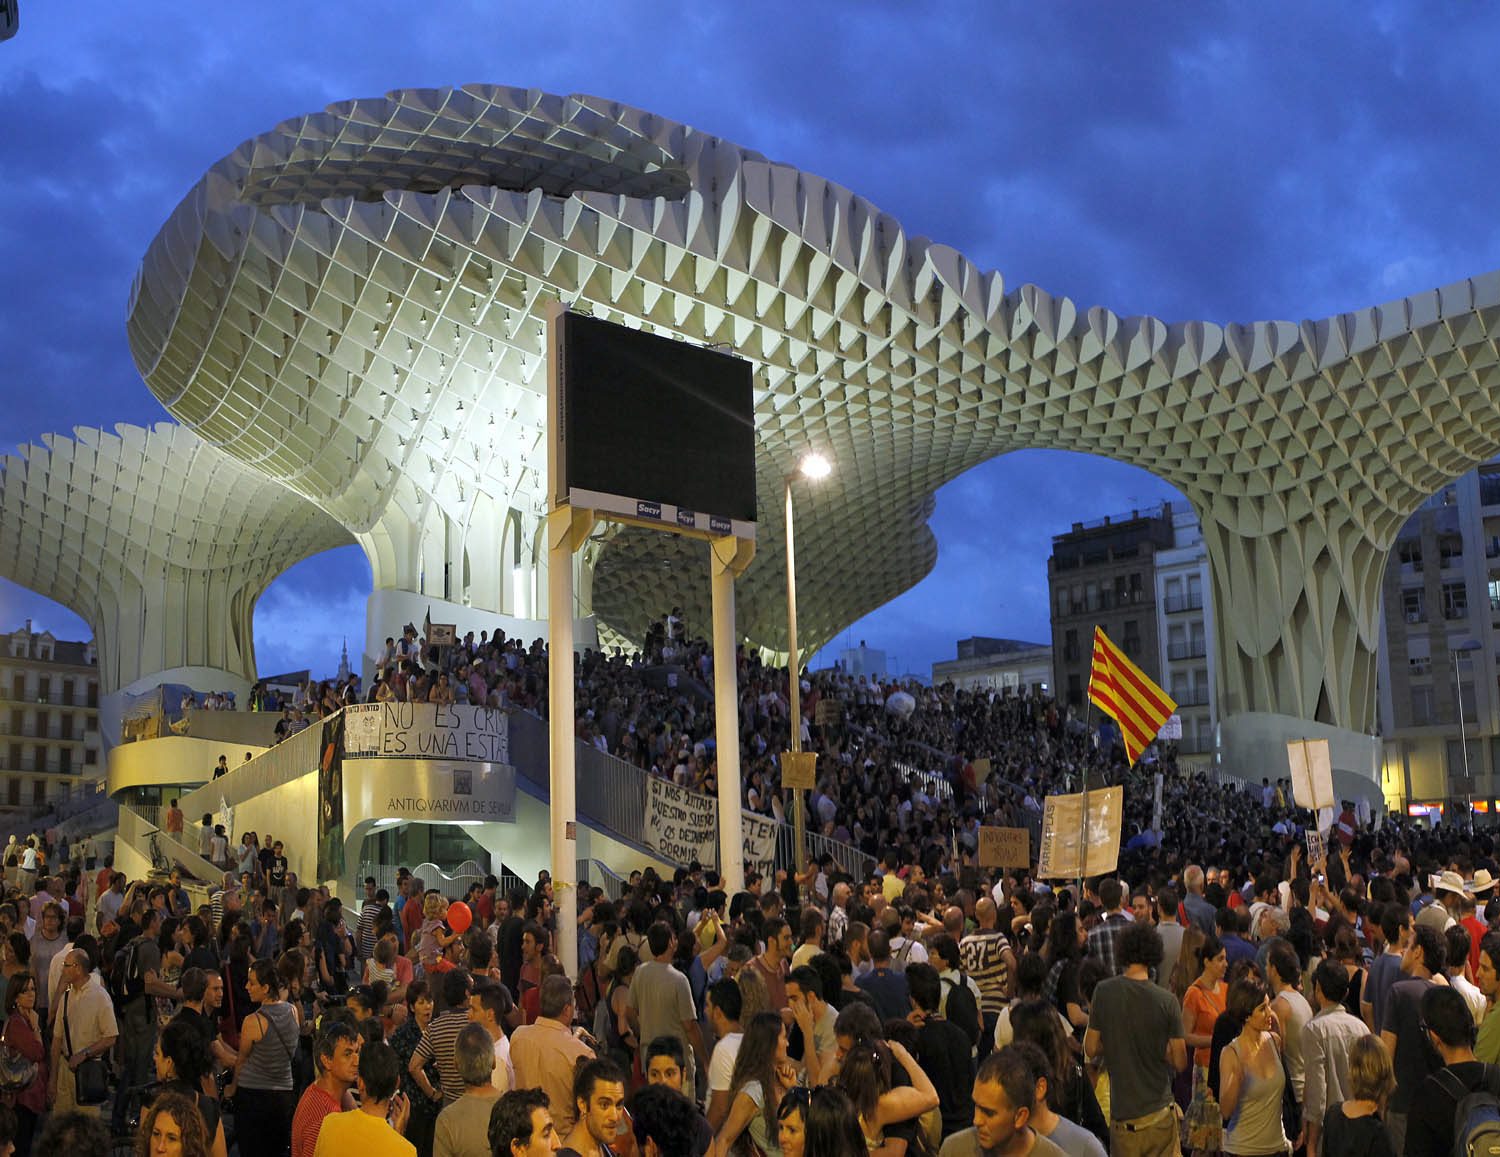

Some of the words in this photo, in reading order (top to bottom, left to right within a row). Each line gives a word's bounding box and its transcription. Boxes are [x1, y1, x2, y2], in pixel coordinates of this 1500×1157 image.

[638, 503, 661, 516] Sacyr
[384, 702, 414, 730] NO
[435, 702, 461, 729] ES
[383, 731, 407, 754] ES
[418, 733, 459, 757] UNA
[652, 781, 661, 796] SI
[664, 786, 681, 802] NOS
[387, 798, 470, 813] ANTIQVARIVM
[472, 801, 486, 813] DE
[659, 838, 698, 861] DORMIR
[966, 940, 987, 970] 27
